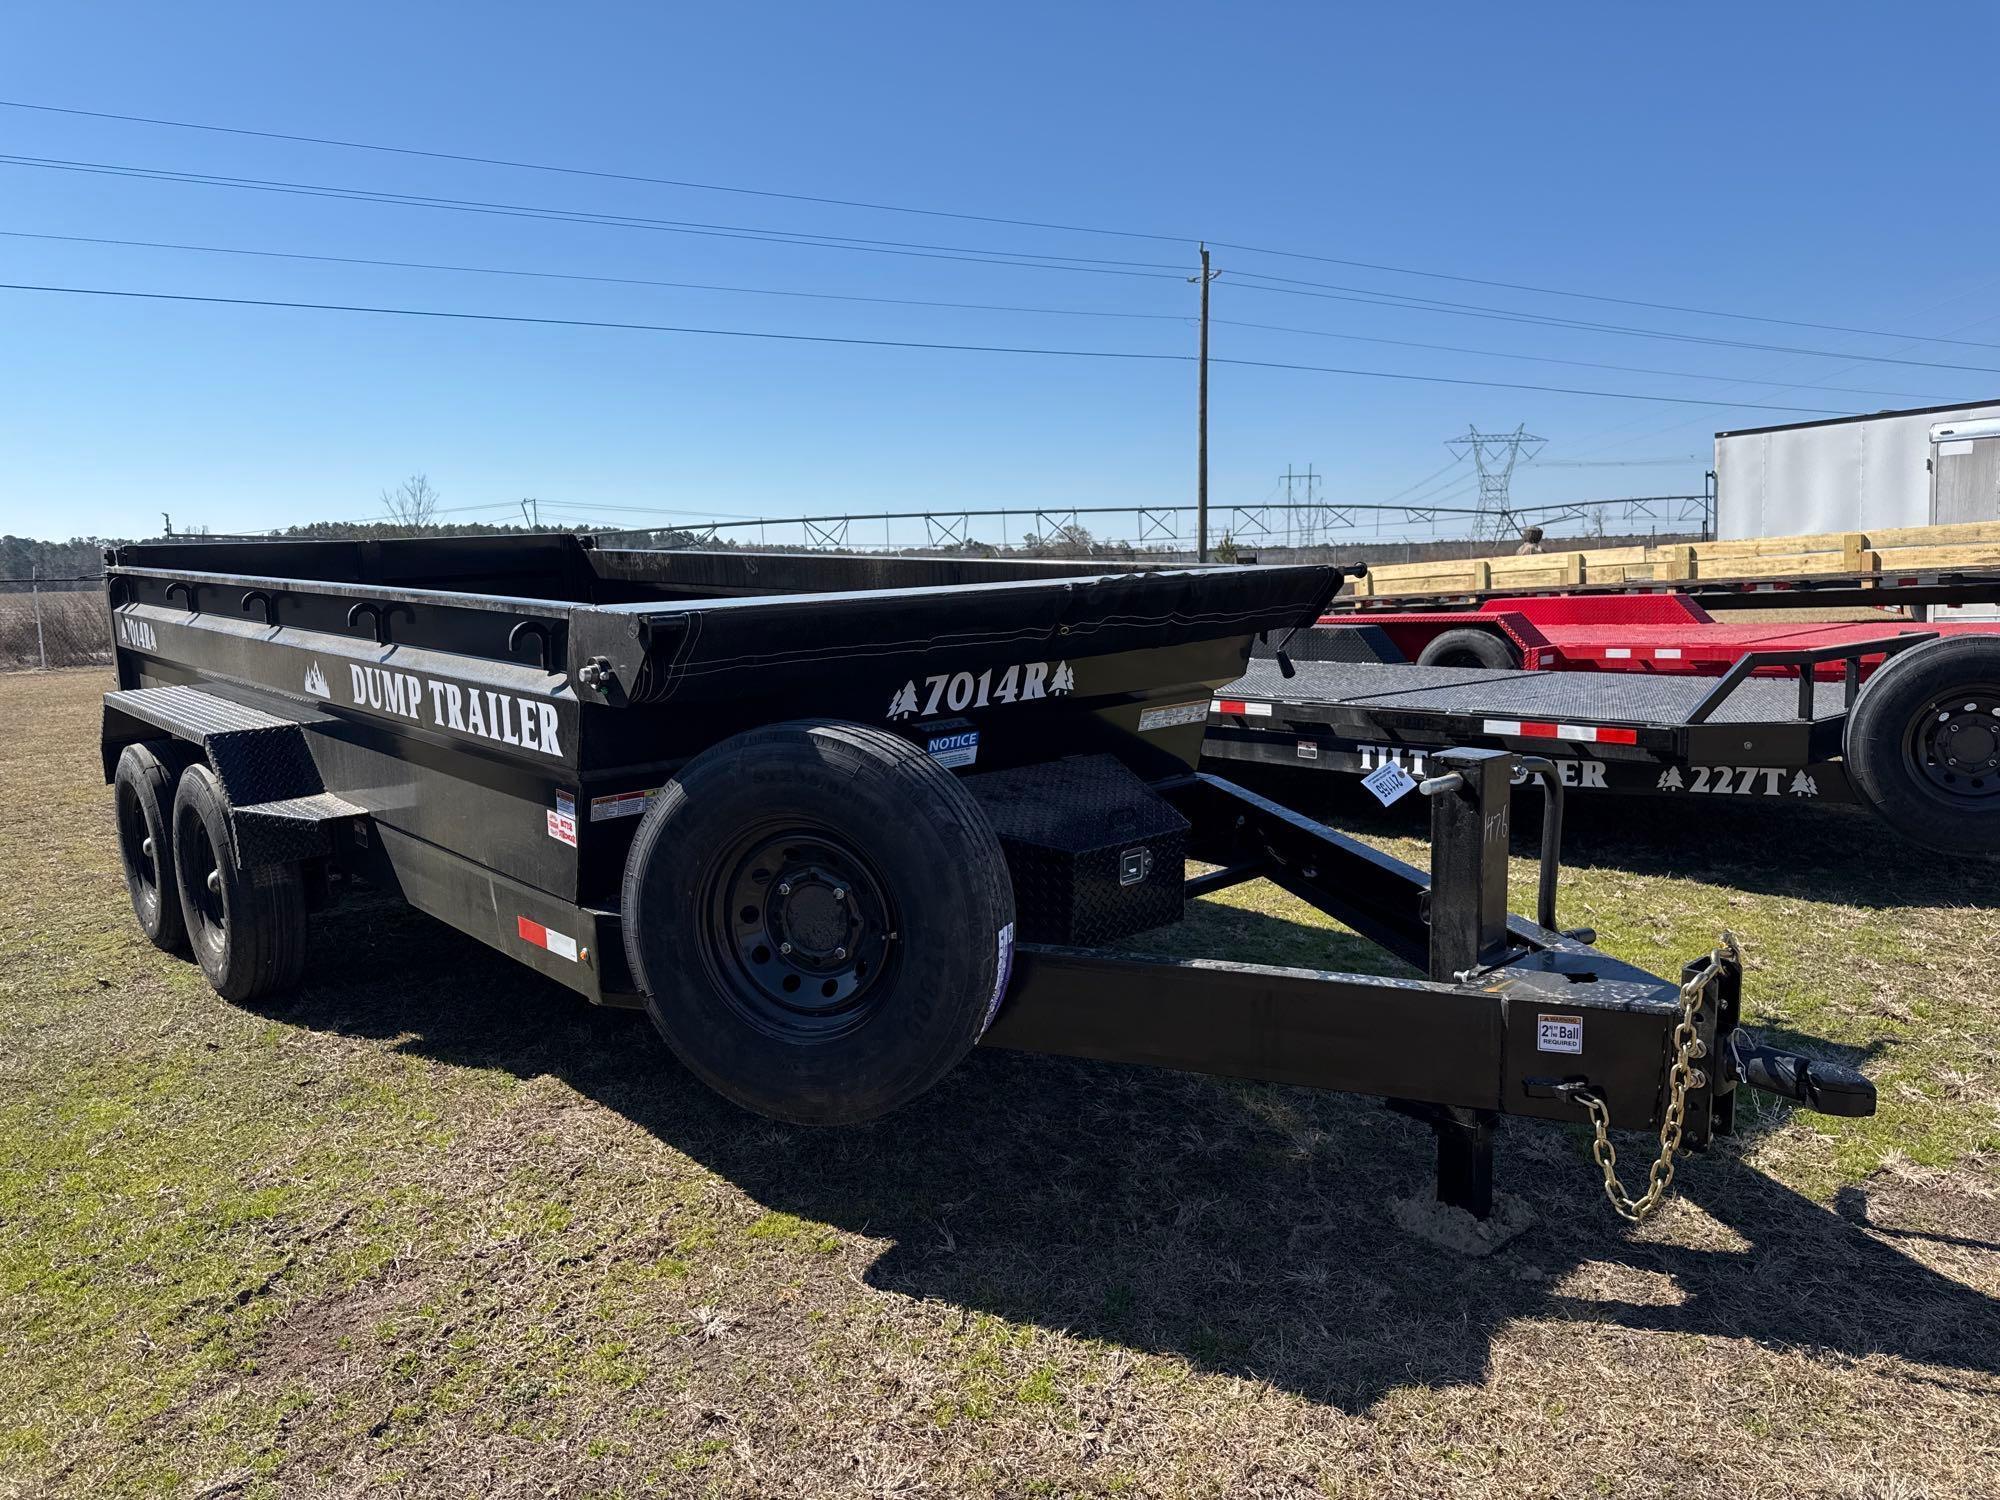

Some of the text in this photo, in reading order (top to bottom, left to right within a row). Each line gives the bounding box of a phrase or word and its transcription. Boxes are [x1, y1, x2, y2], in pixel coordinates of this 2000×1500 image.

[125, 617, 152, 651] 7014R
[921, 661, 1048, 716] 7014R
[349, 663, 564, 758] DUMP TRAILER
[929, 733, 977, 752] NOTICE
[1357, 744, 1428, 775] TILT
[1688, 766, 1787, 796] 227T
[1543, 1038, 1577, 1047] REQUIRED
[1559, 1026, 1579, 1039] Ball
